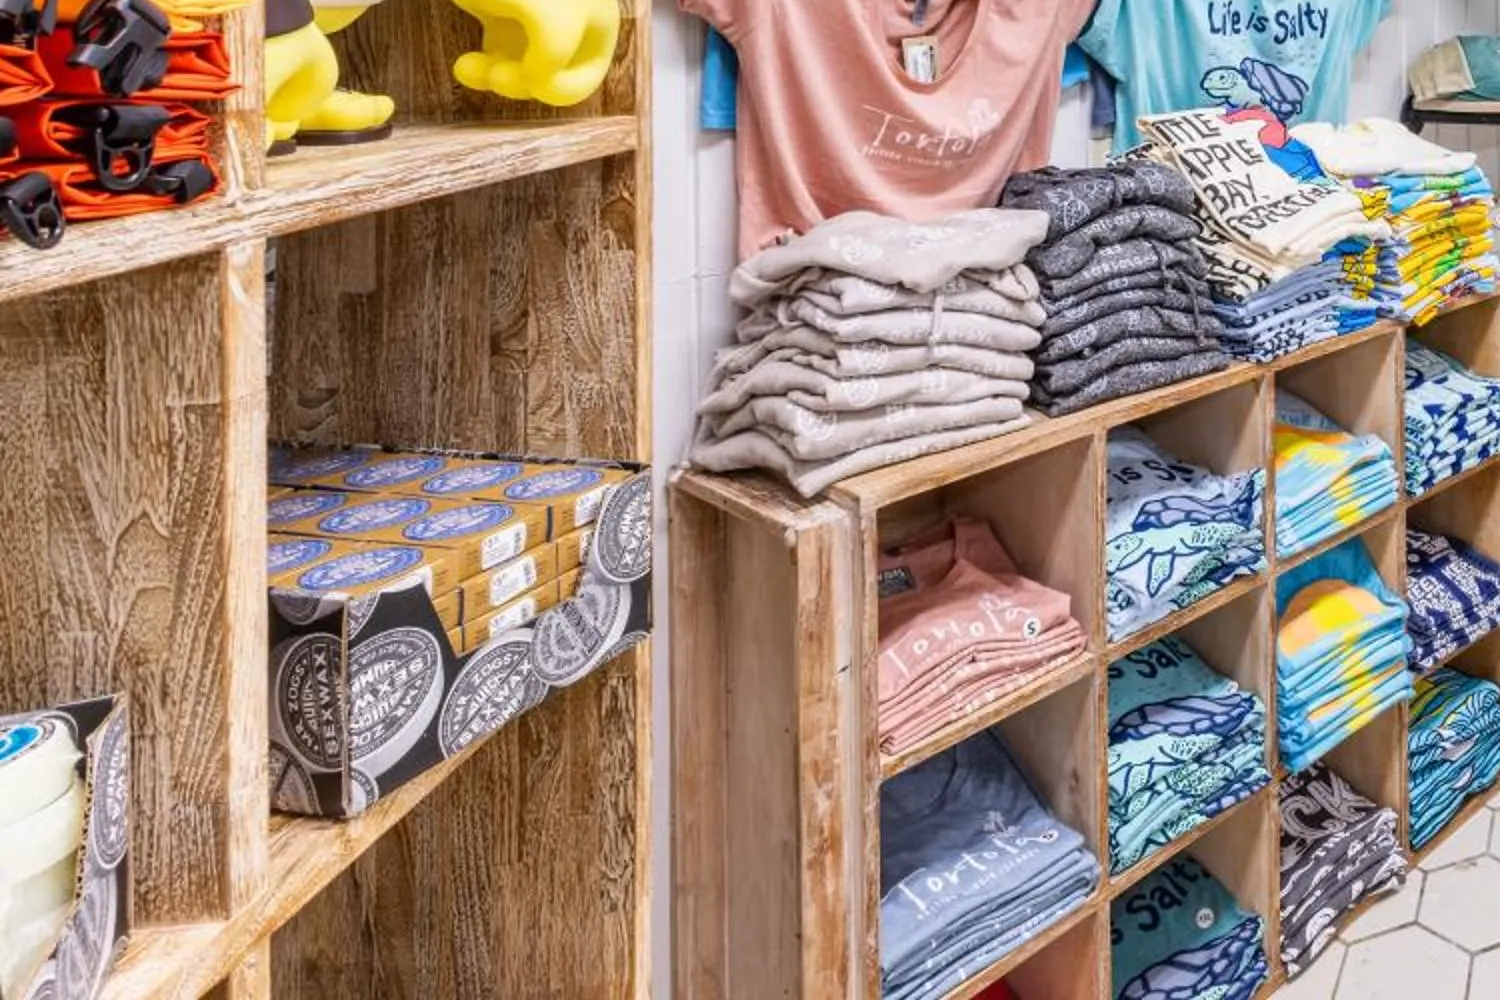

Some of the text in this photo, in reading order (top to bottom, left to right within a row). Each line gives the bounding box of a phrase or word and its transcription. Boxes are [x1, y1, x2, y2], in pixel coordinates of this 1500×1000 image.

[1207, 0, 1329, 45] Life is Salty
[861, 104, 982, 158] Tortol
[1176, 138, 1264, 181] APPLE
[1126, 638, 1194, 679] Salt
